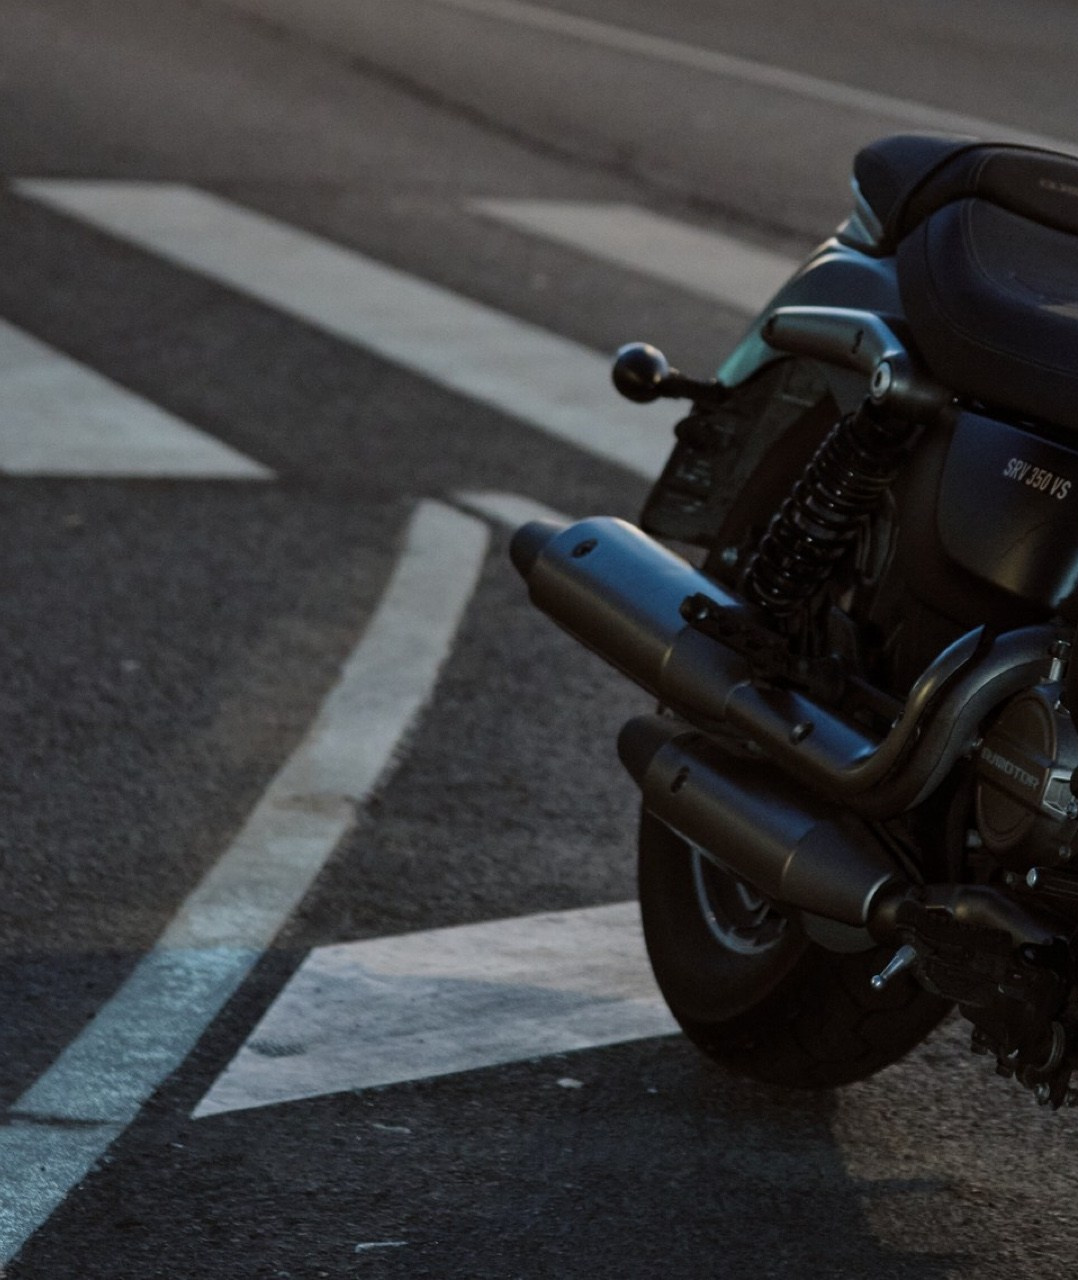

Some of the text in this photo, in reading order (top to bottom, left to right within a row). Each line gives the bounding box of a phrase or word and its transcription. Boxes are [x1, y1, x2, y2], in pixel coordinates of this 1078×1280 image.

[1003, 457, 1073, 500] SRV 350 VS
